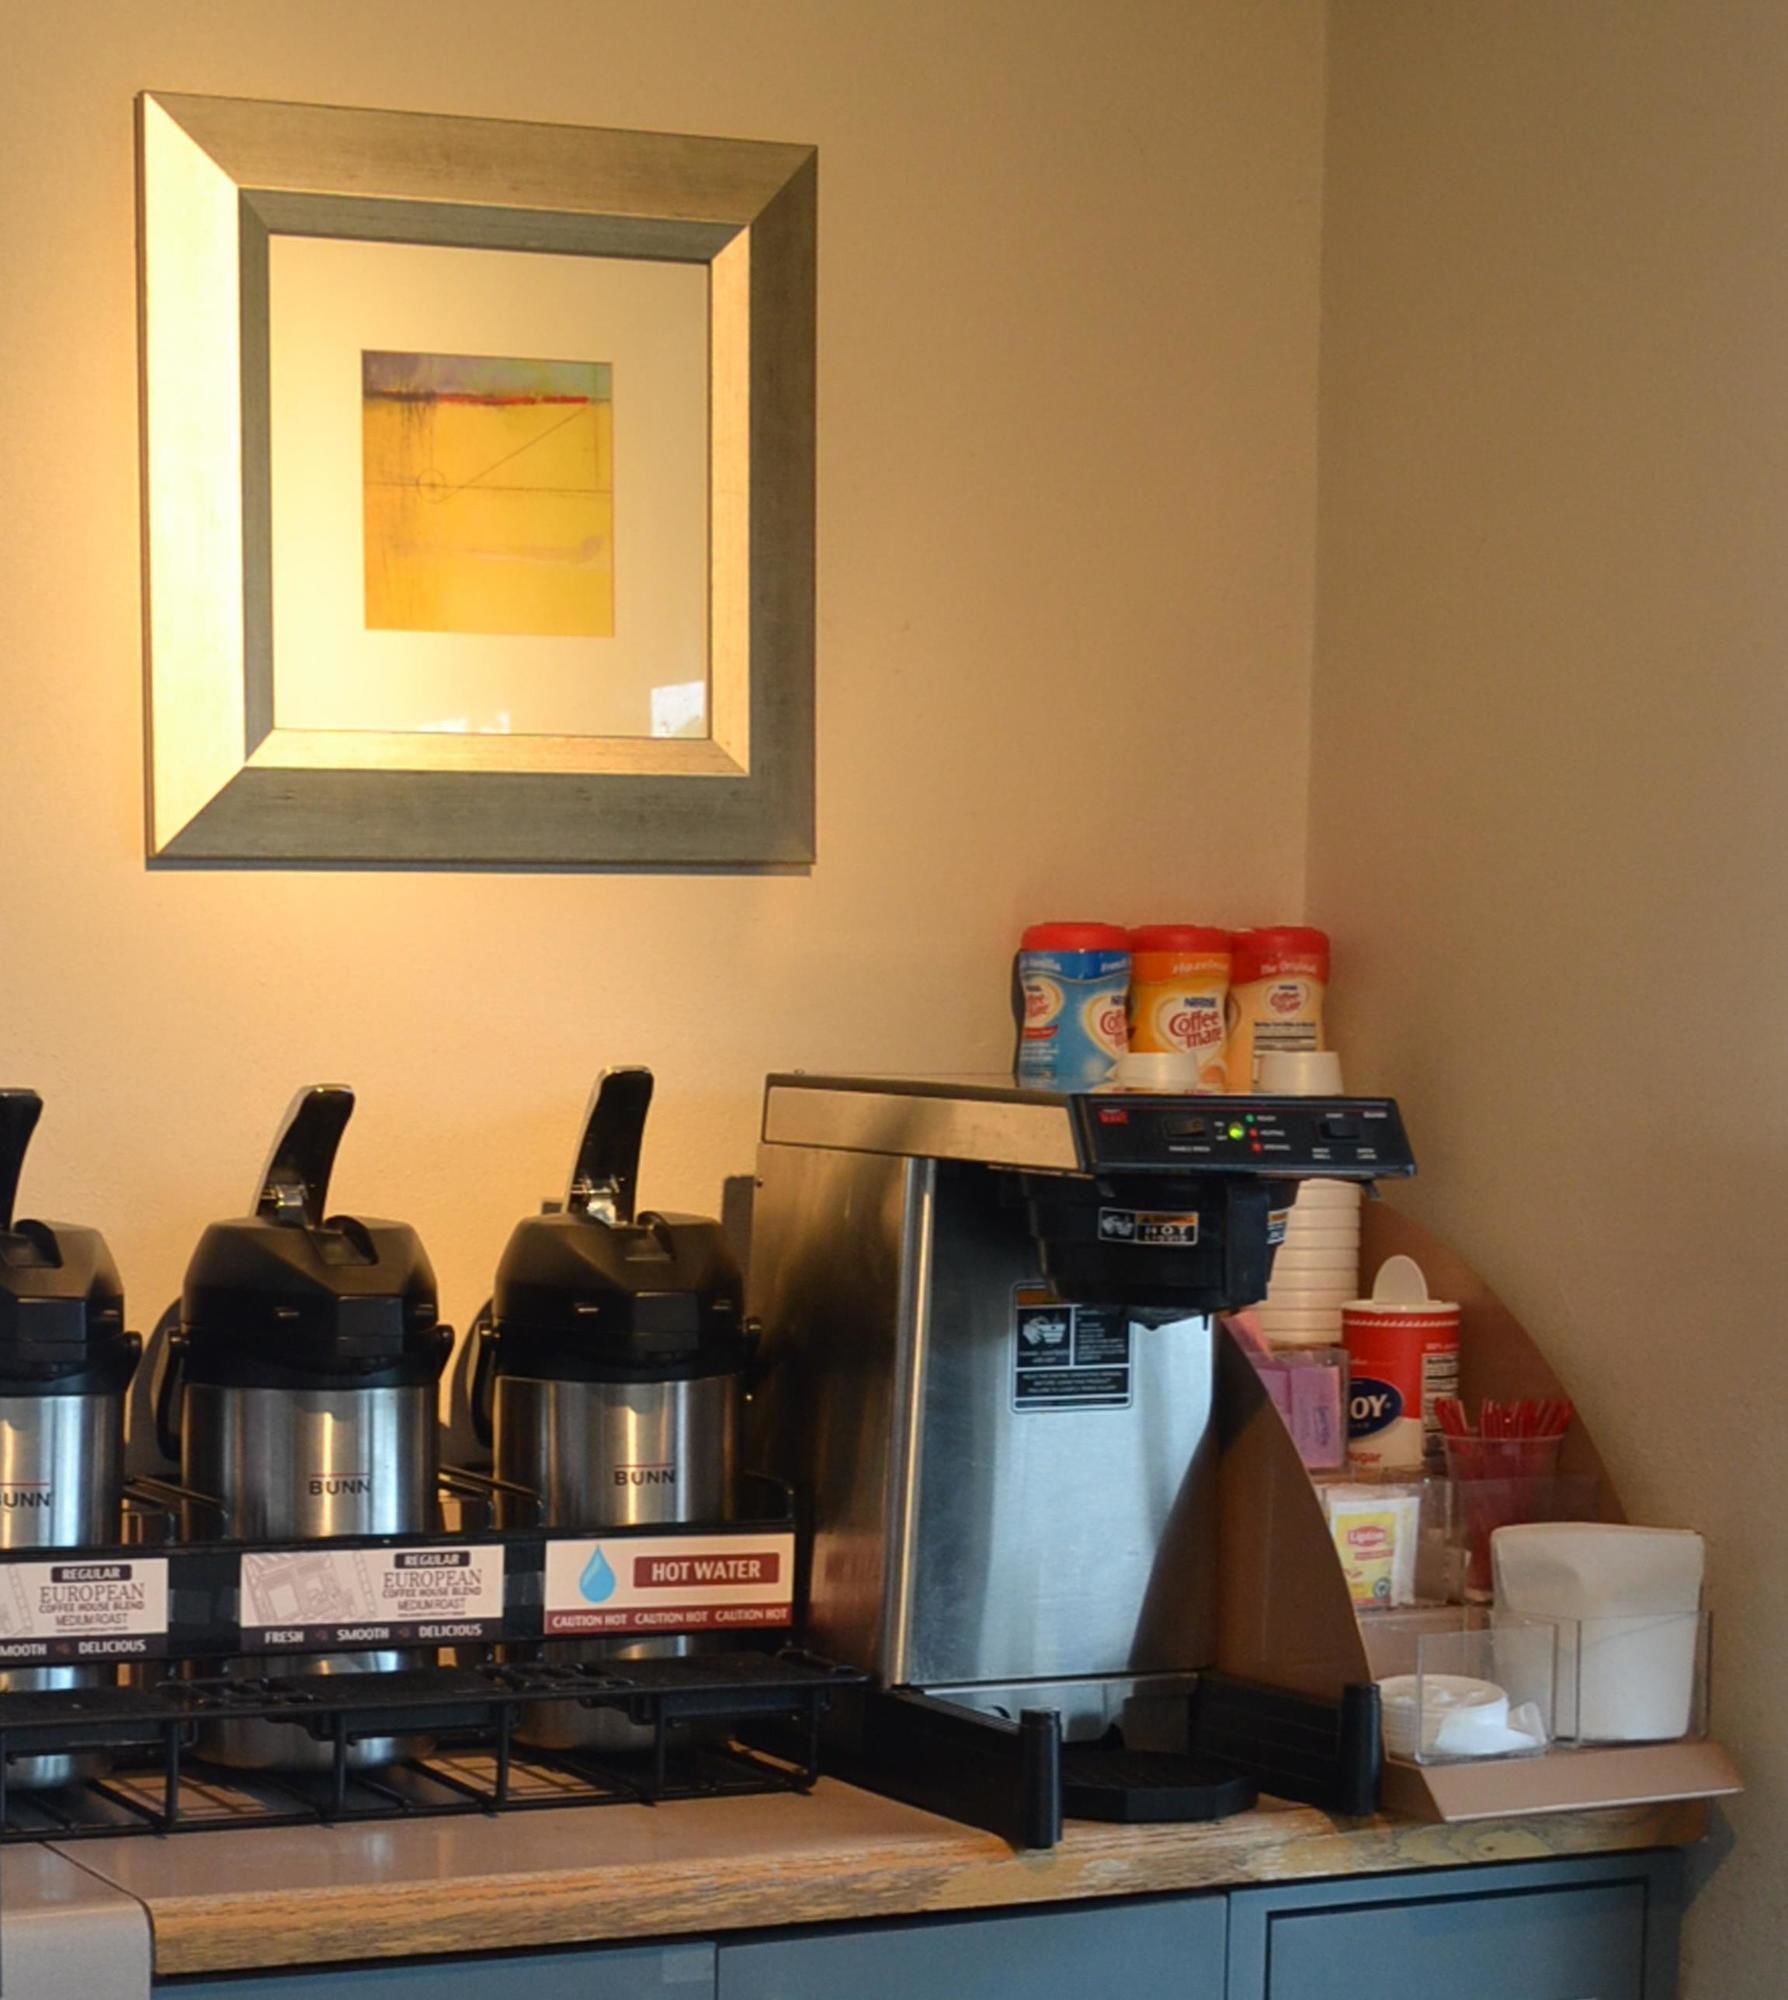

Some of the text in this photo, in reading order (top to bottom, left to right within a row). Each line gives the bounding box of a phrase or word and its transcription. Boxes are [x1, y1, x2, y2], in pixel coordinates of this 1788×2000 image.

[1168, 1010, 1220, 1037] Coffee
[1350, 1395, 1387, 1420] OY
[614, 1470, 675, 1486] BUNN
[309, 1480, 370, 1496] BUNN
[0, 1491, 50, 1508] UNN
[404, 1554, 460, 1567] REGULAR
[61, 1567, 121, 1580] REGULAR
[383, 1570, 482, 1589] EUROPEAN
[652, 1560, 761, 1582] HOT WATER
[39, 1583, 145, 1602] EUROPEAN
[382, 1587, 482, 1599] COFFEE HOUSE BLEND
[39, 1600, 145, 1614] COFFEE HOUSE BLEND
[397, 1600, 436, 1611] MEDIUM
[56, 1614, 96, 1626] MEDIUM
[553, 1608, 788, 1628] CAUTION HOT CAUTION HOT CAUTION HOT
[264, 1624, 482, 1644] FRESH SMOOTH DELICIOUS
[0, 1639, 146, 1657] MOOTH DELICIOUS
